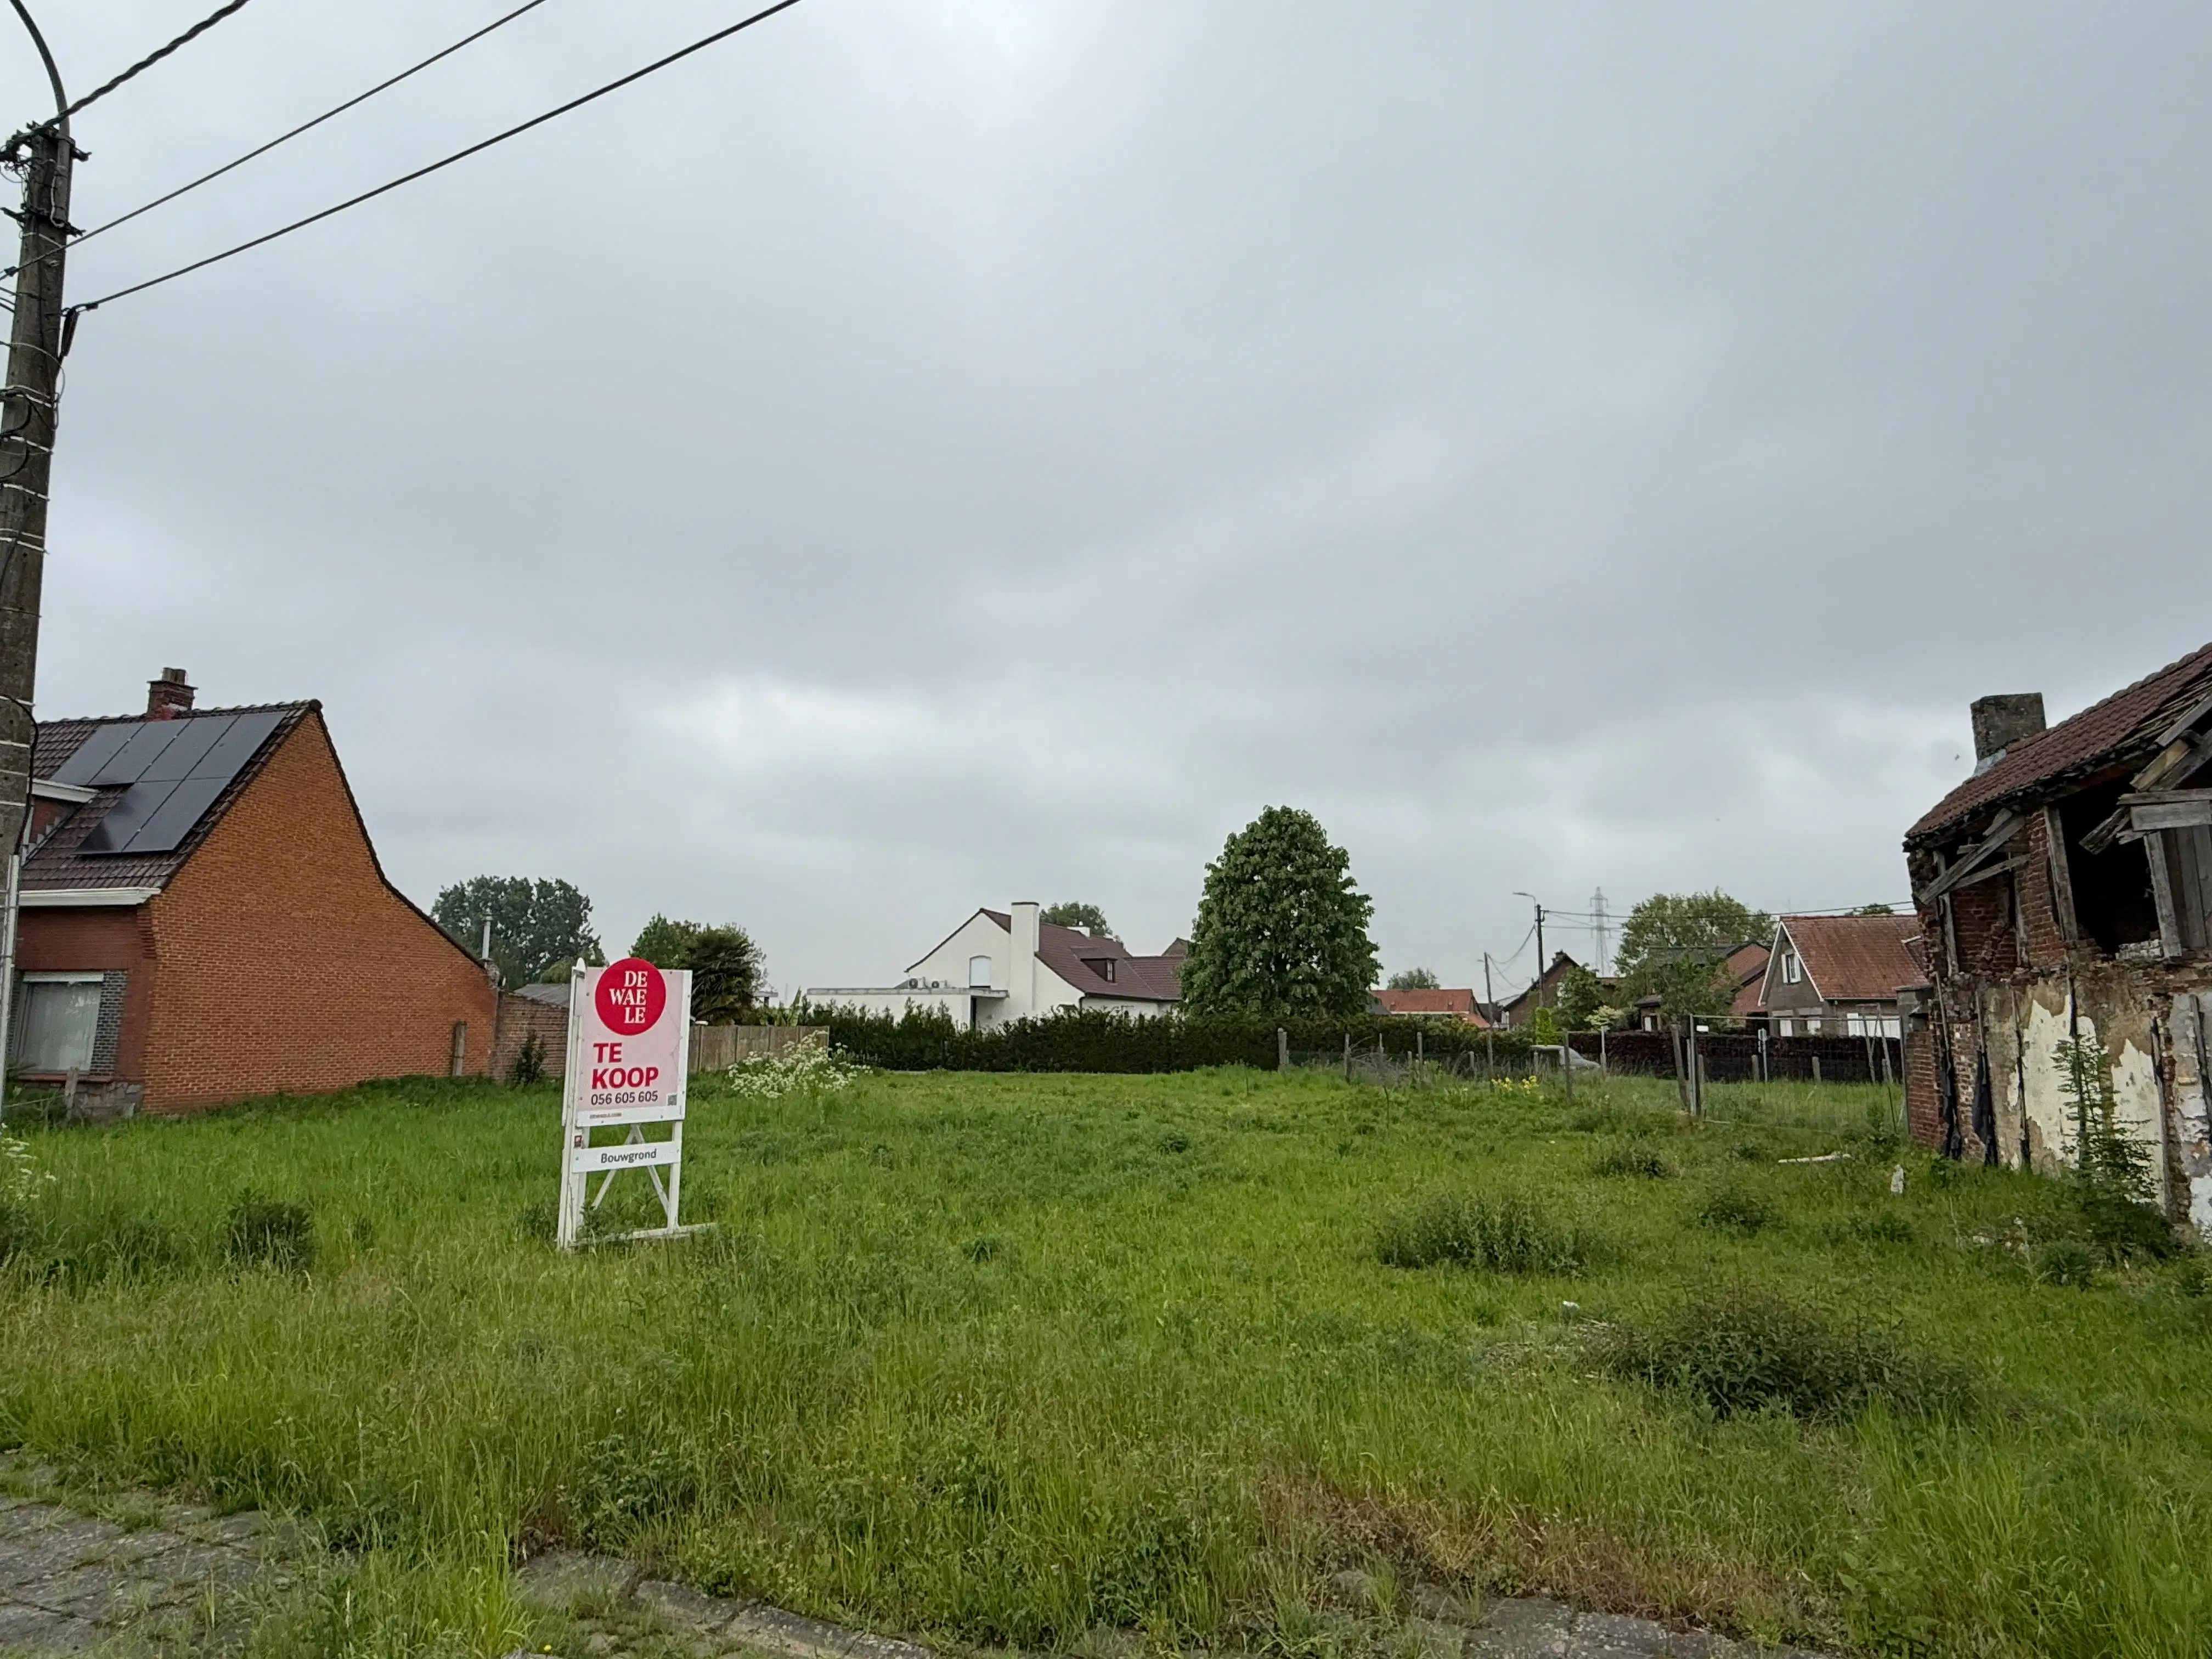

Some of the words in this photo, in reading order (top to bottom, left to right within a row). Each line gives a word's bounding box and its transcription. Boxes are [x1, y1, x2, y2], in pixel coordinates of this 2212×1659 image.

[624, 971, 648, 987] DE
[609, 988, 647, 1005] WAE
[624, 1007, 646, 1024] LE
[593, 1042, 622, 1063] TE
[591, 1066, 659, 1090] KOOP
[591, 1093, 612, 1105] 056
[614, 1092, 635, 1104] 605
[637, 1090, 658, 1102] 605
[601, 1148, 657, 1163] Bouwgrond
